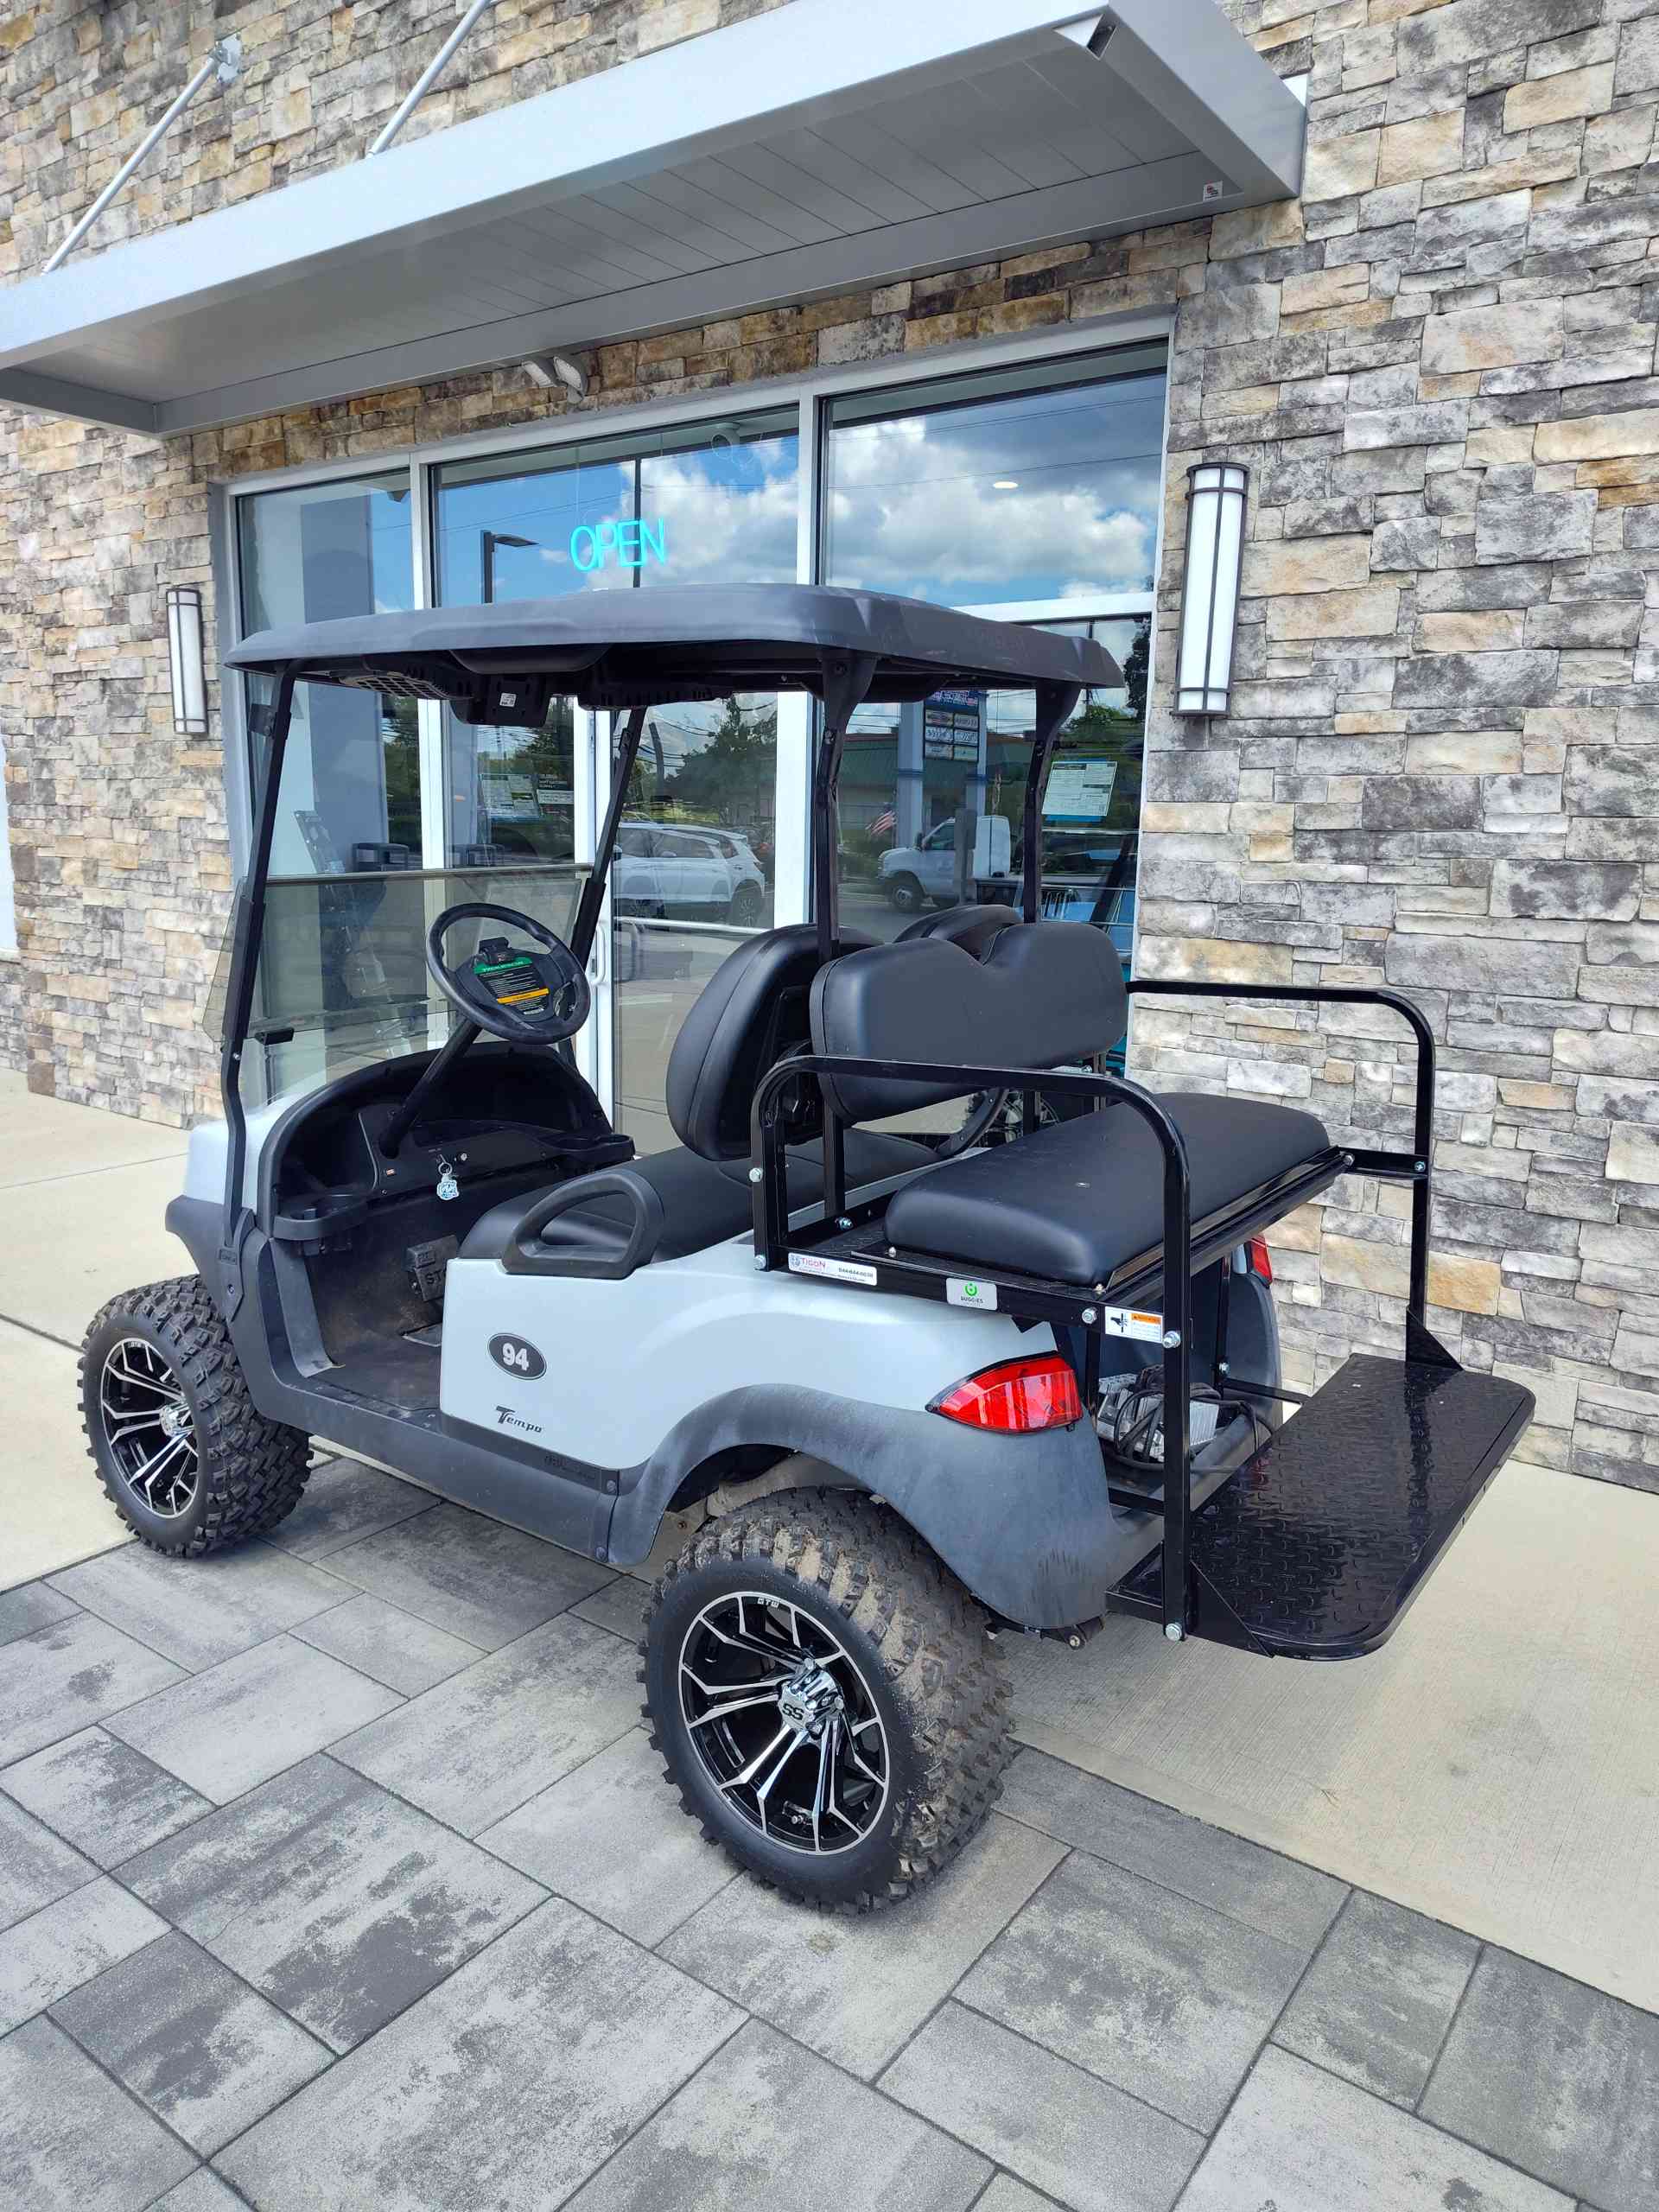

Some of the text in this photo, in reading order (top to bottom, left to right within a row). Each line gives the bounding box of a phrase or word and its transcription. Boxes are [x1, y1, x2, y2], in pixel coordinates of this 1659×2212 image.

[570, 518, 664, 571] OPEN
[502, 1343, 529, 1370] 94
[496, 1405, 543, 1433] Tempo
[782, 1703, 804, 1720] SS
